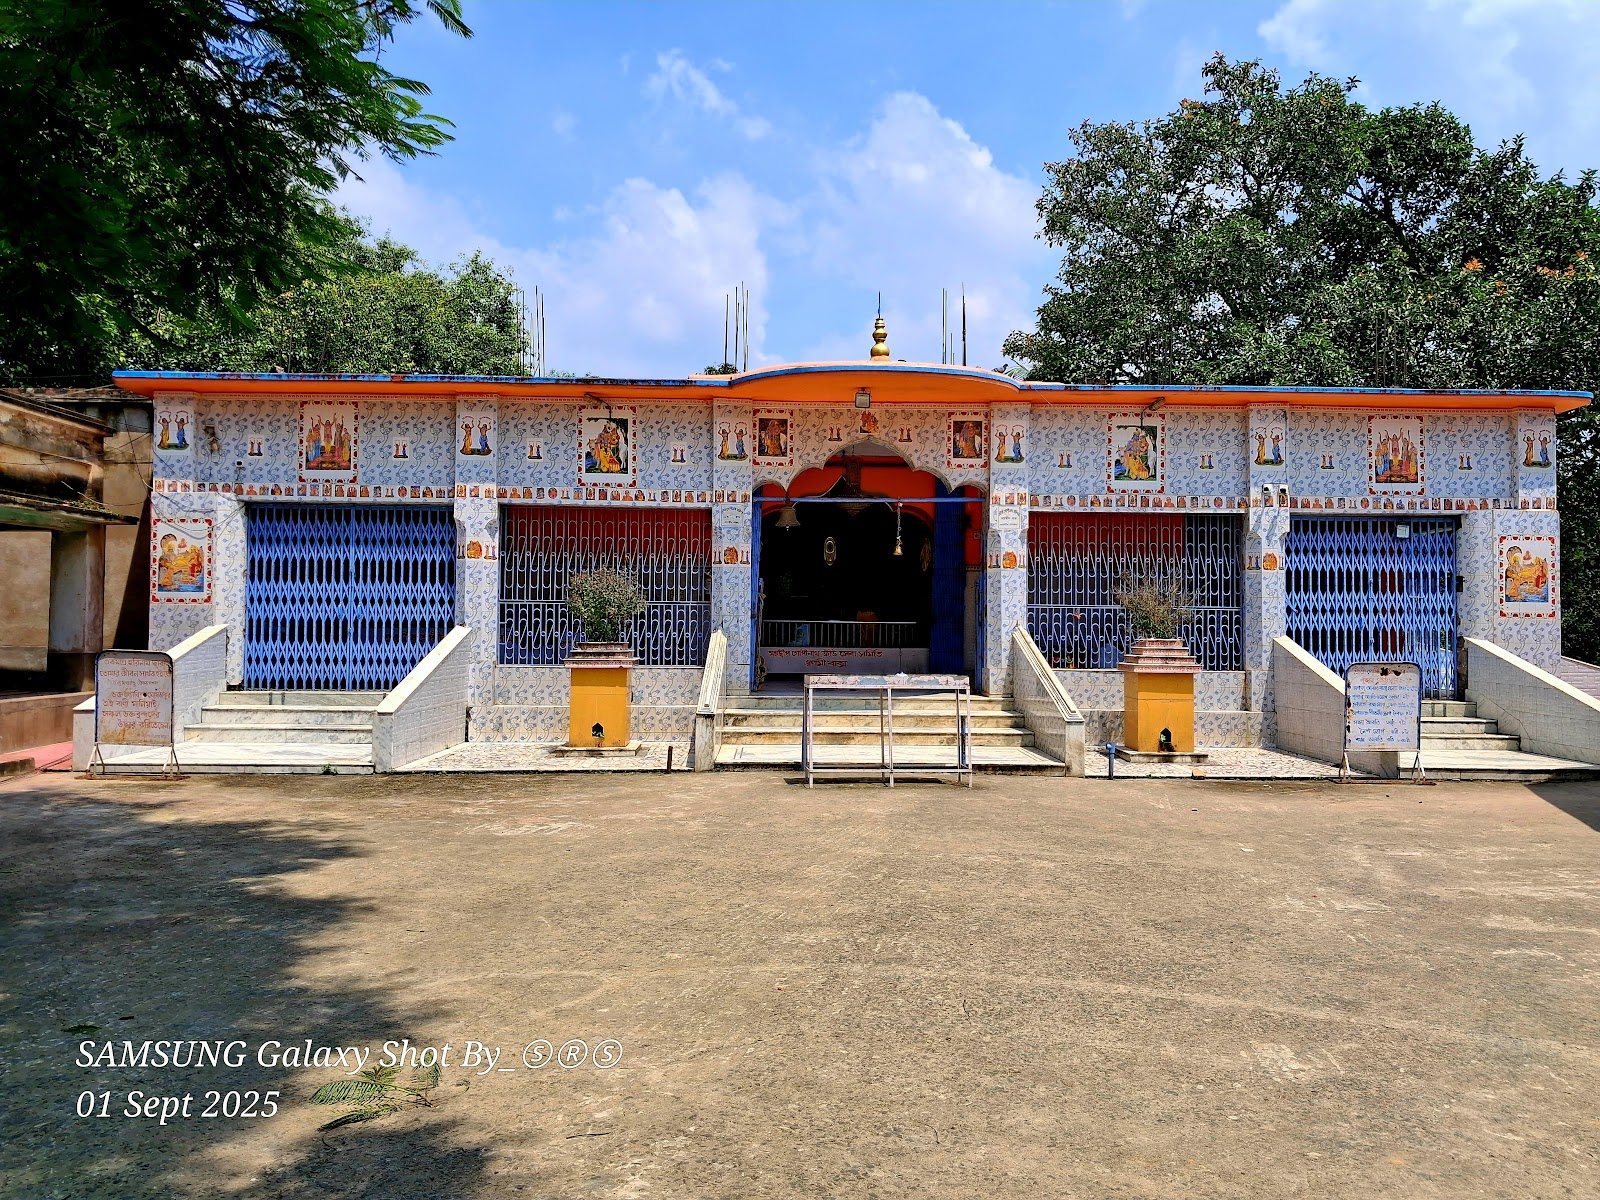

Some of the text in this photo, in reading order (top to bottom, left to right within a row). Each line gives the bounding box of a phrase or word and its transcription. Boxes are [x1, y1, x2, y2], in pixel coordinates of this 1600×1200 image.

[858, 649, 883, 657] সমিতি
[128, 658, 150, 666] হরিনাম
[121, 667, 138, 677] জীবন
